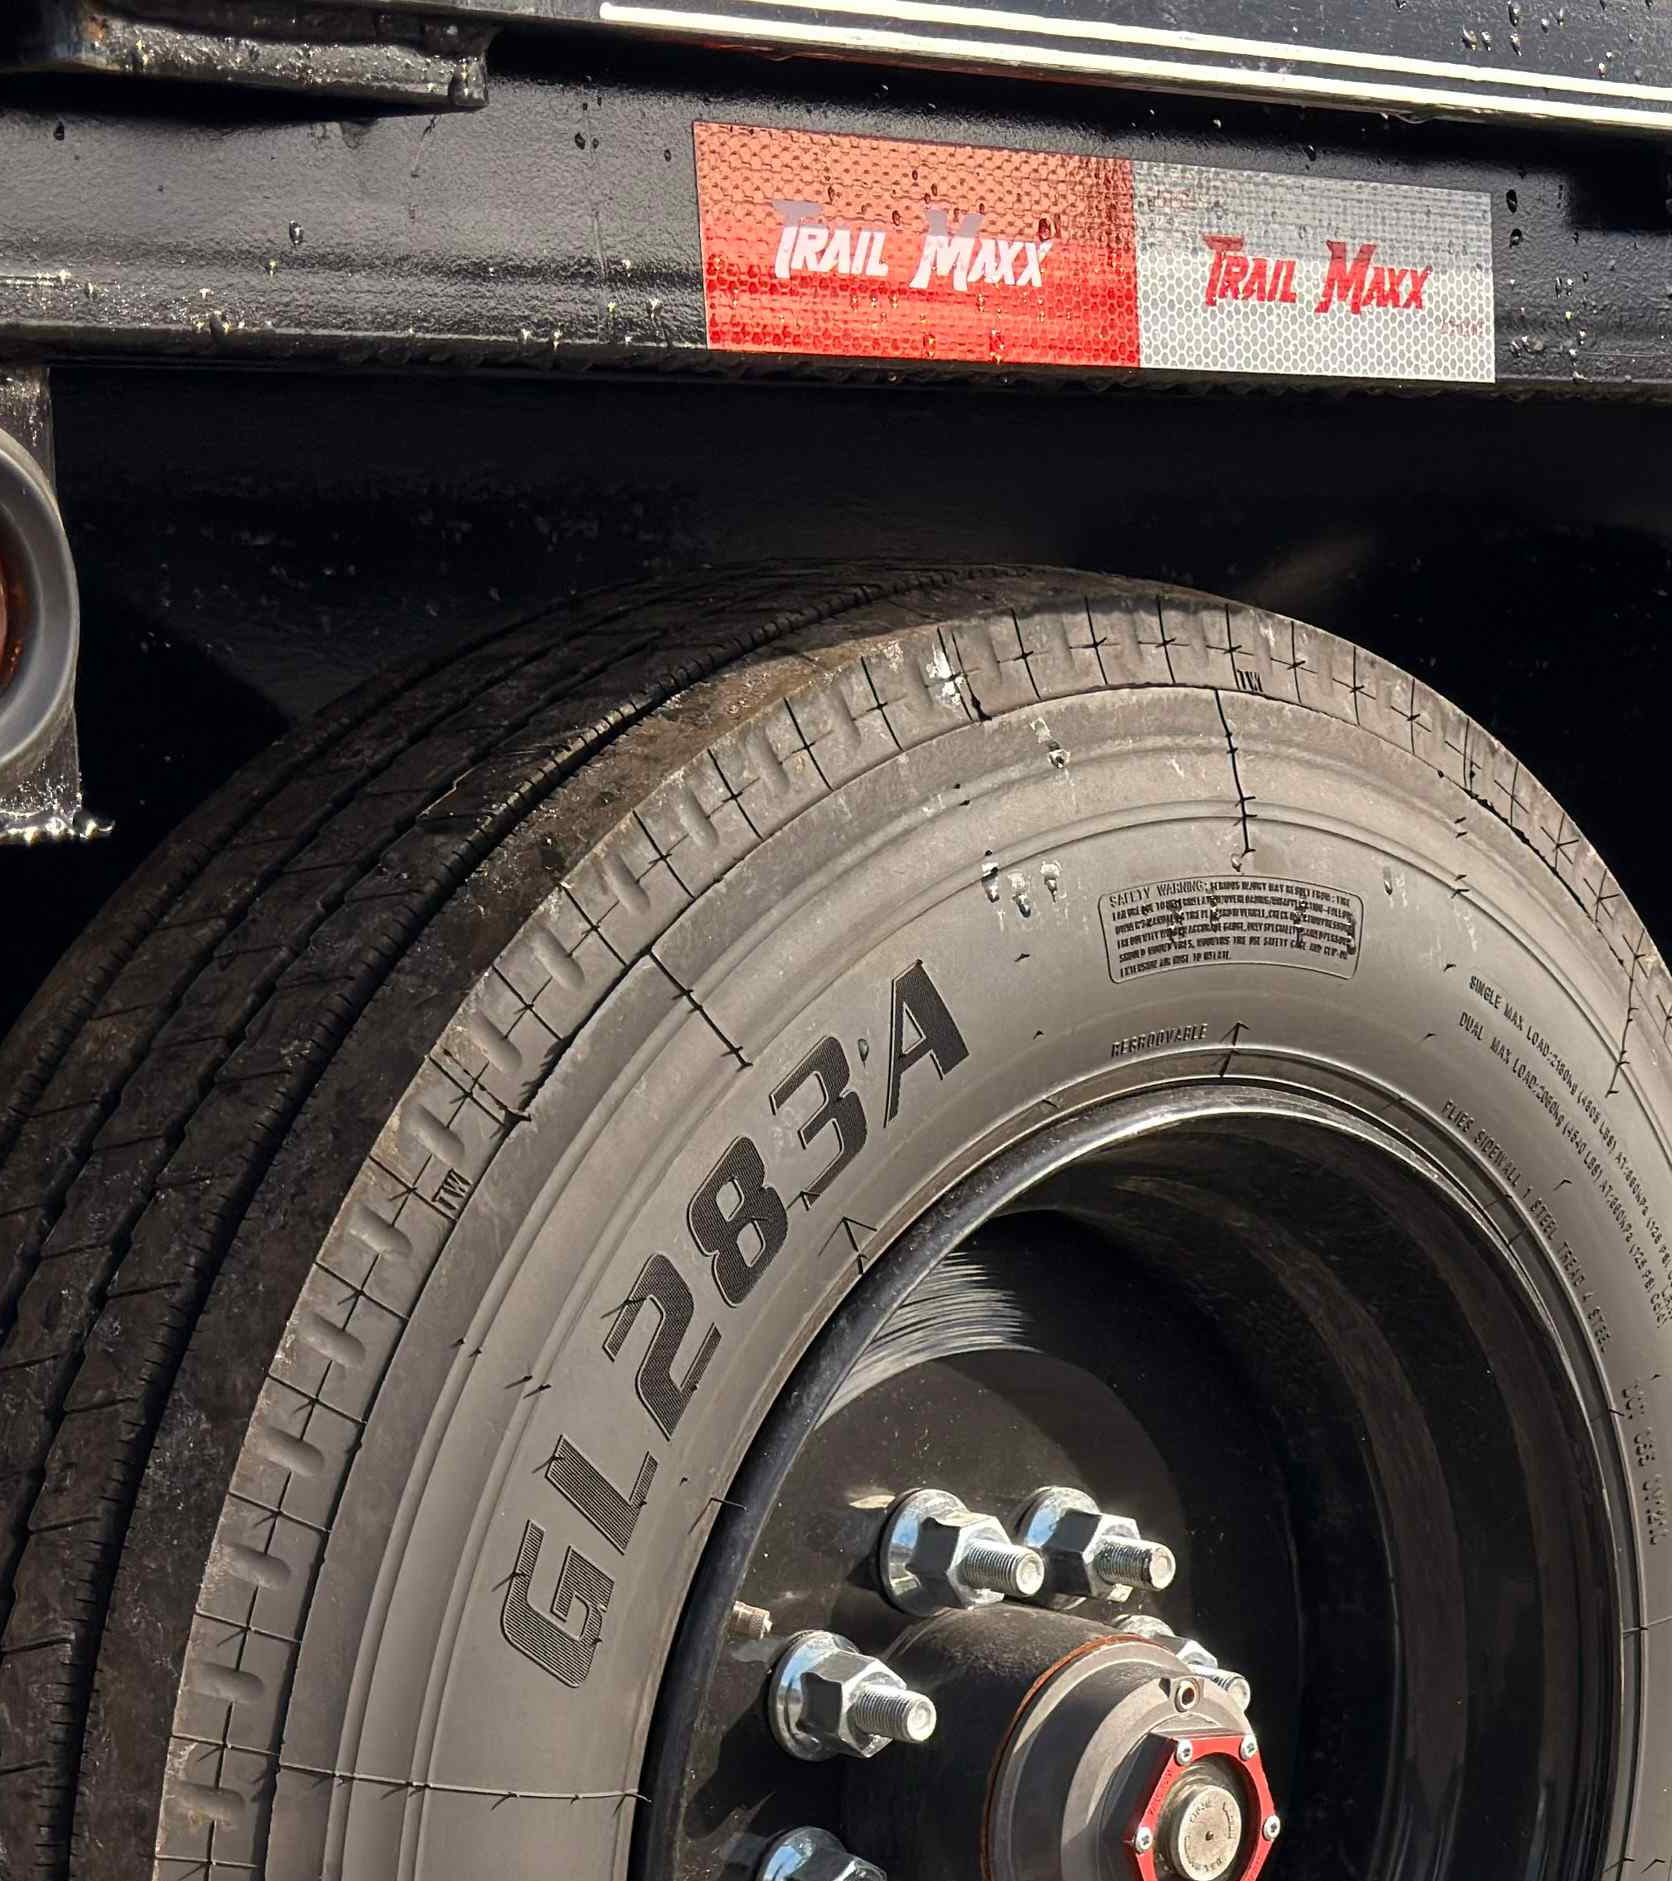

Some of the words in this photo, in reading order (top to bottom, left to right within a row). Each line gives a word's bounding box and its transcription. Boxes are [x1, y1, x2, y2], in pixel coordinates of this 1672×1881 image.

[771, 201, 890, 279] TRAIL
[908, 210, 1054, 291] MAXX
[1204, 235, 1299, 307] TRAIL
[1315, 240, 1434, 315] MAXX
[500, 959, 972, 1690] GL283A
